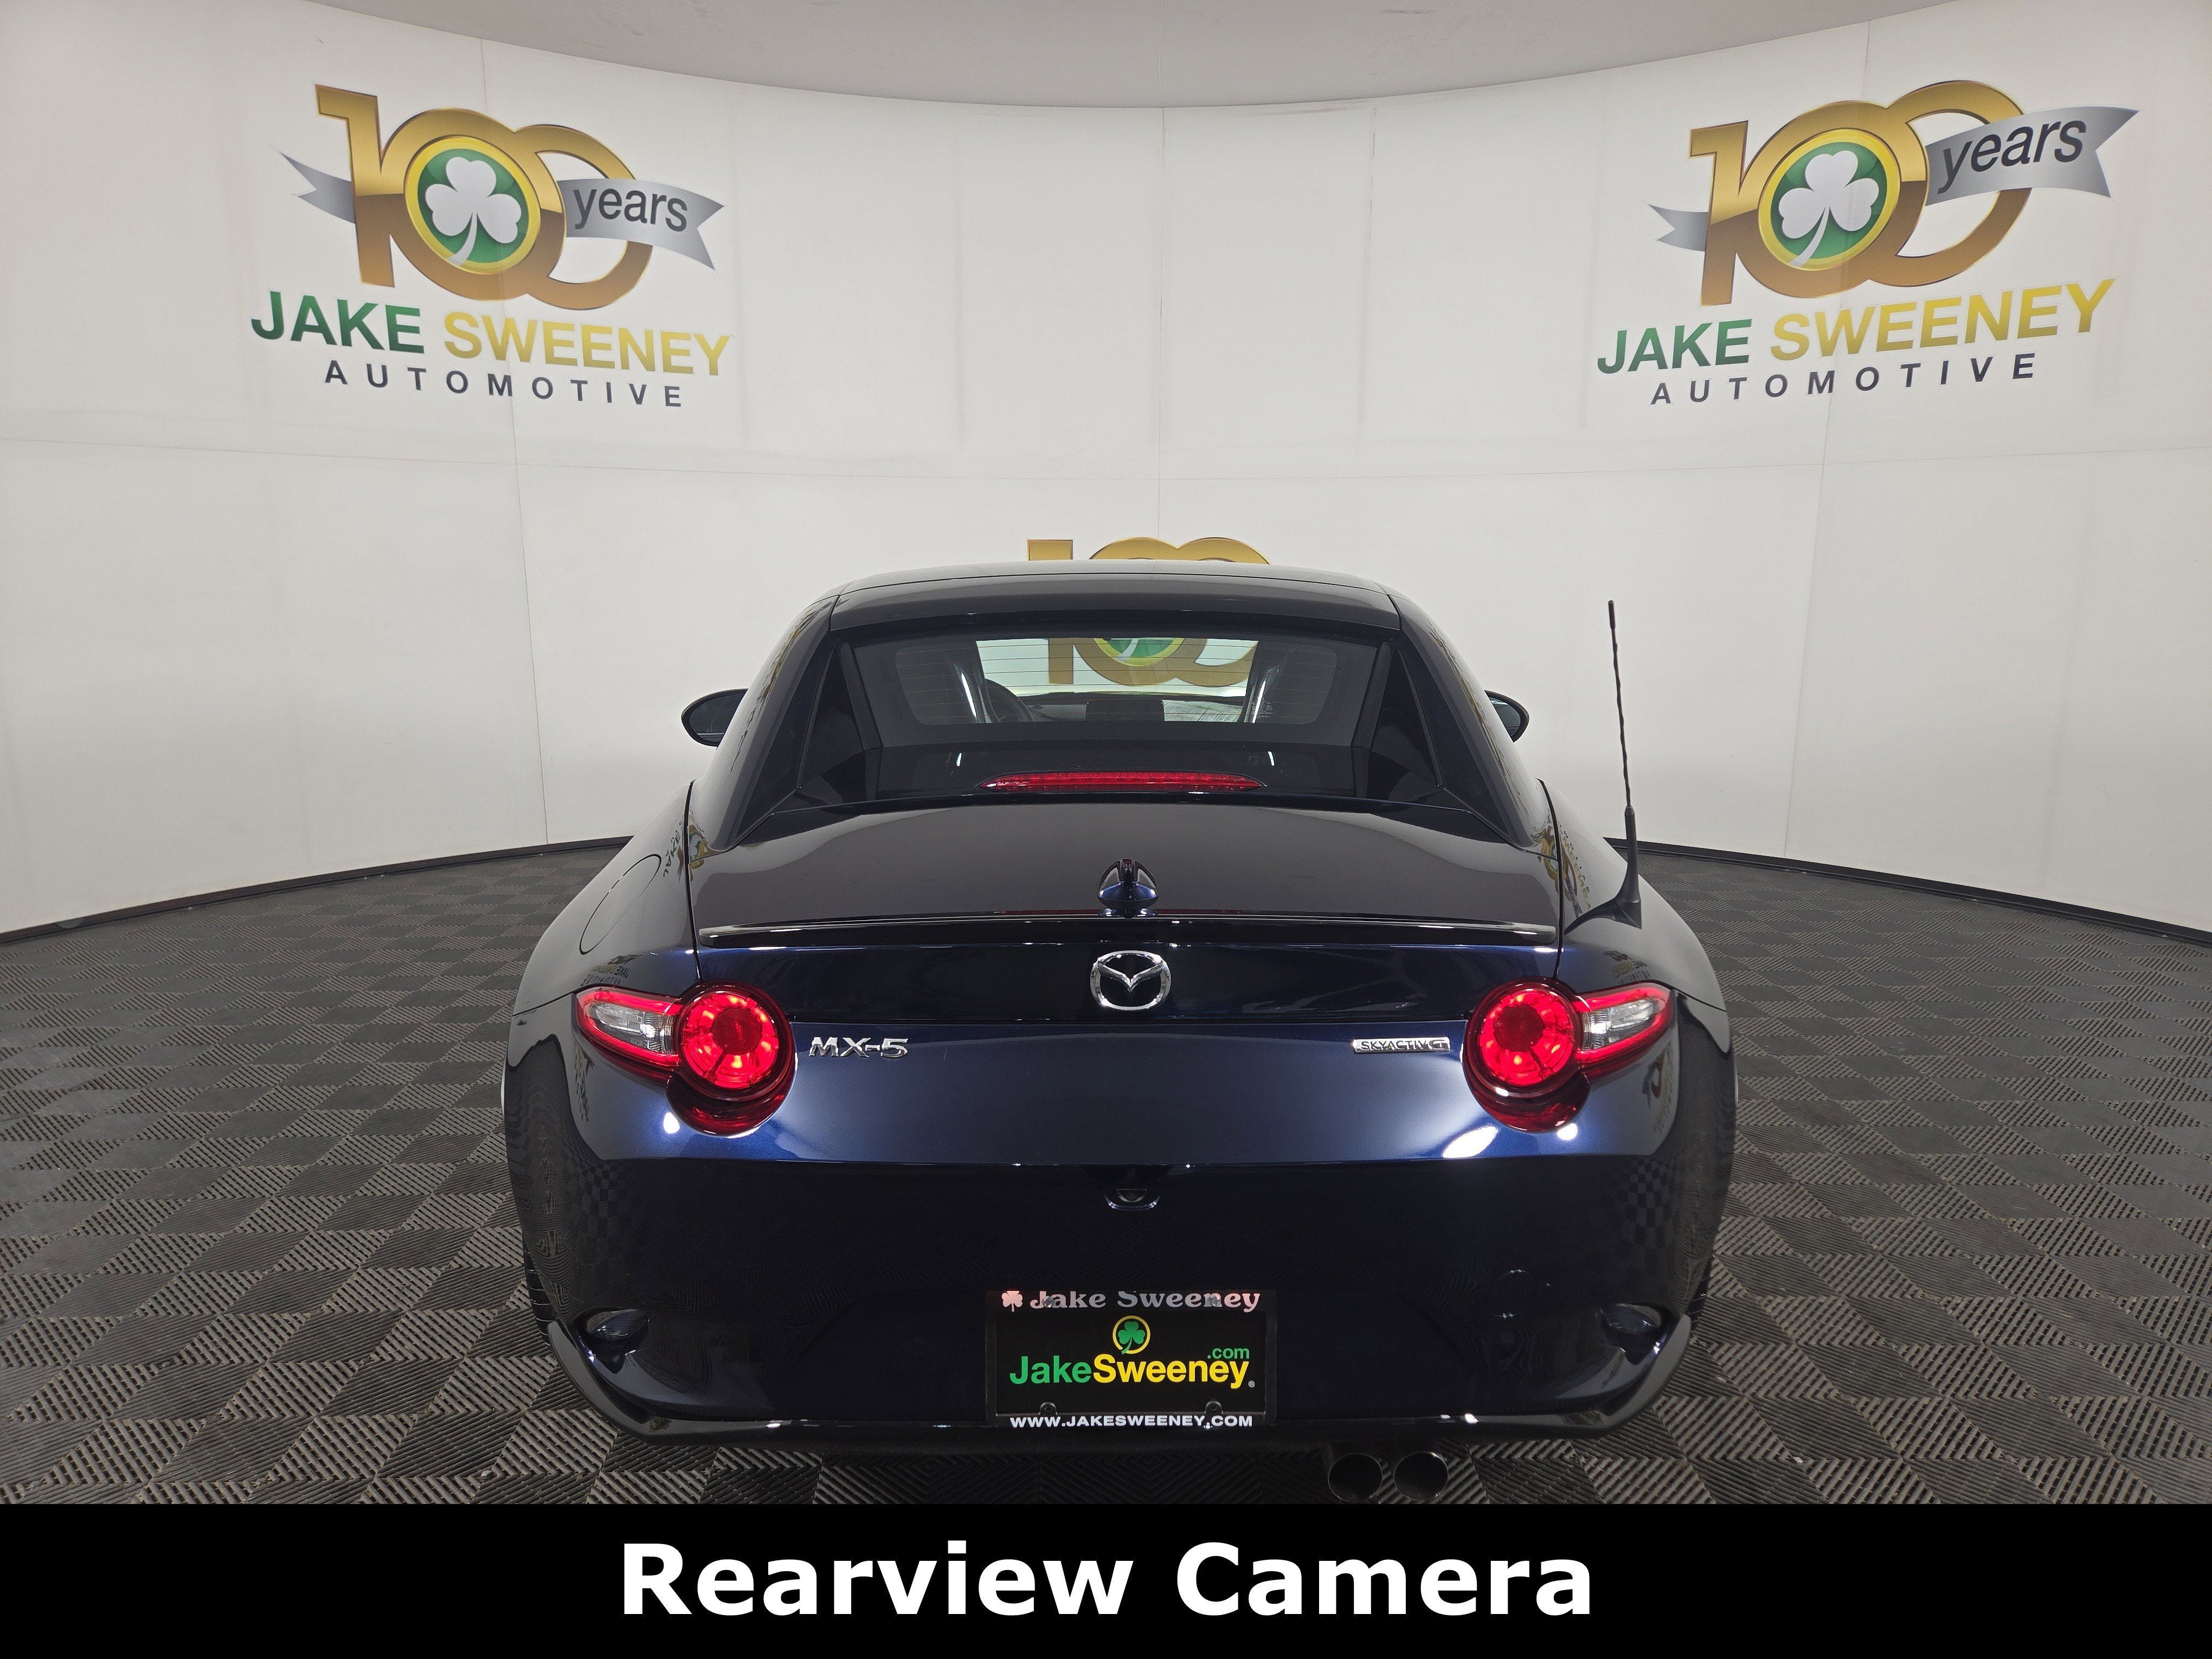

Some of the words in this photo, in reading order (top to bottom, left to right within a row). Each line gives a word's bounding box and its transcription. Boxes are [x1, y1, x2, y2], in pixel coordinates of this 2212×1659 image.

[1937, 119, 2087, 195] years
[315, 83, 653, 310] 100
[573, 186, 688, 232] years
[1689, 80, 2033, 307] 100
[250, 290, 425, 355] JAKE
[443, 311, 734, 376] SWEENEY
[1597, 318, 1753, 375] JAKE
[1770, 278, 2117, 362] SWEENEY
[325, 359, 683, 407] AUTOMOTIVE
[1650, 352, 2036, 405] AUTOMOTIVE
[809, 1037, 909, 1058] MX-5
[1030, 1290, 1106, 1309] Jake
[1117, 1290, 1261, 1313] Sweeney
[1010, 1415, 1253, 1428] WWW.JAKESWEENEY.COM
